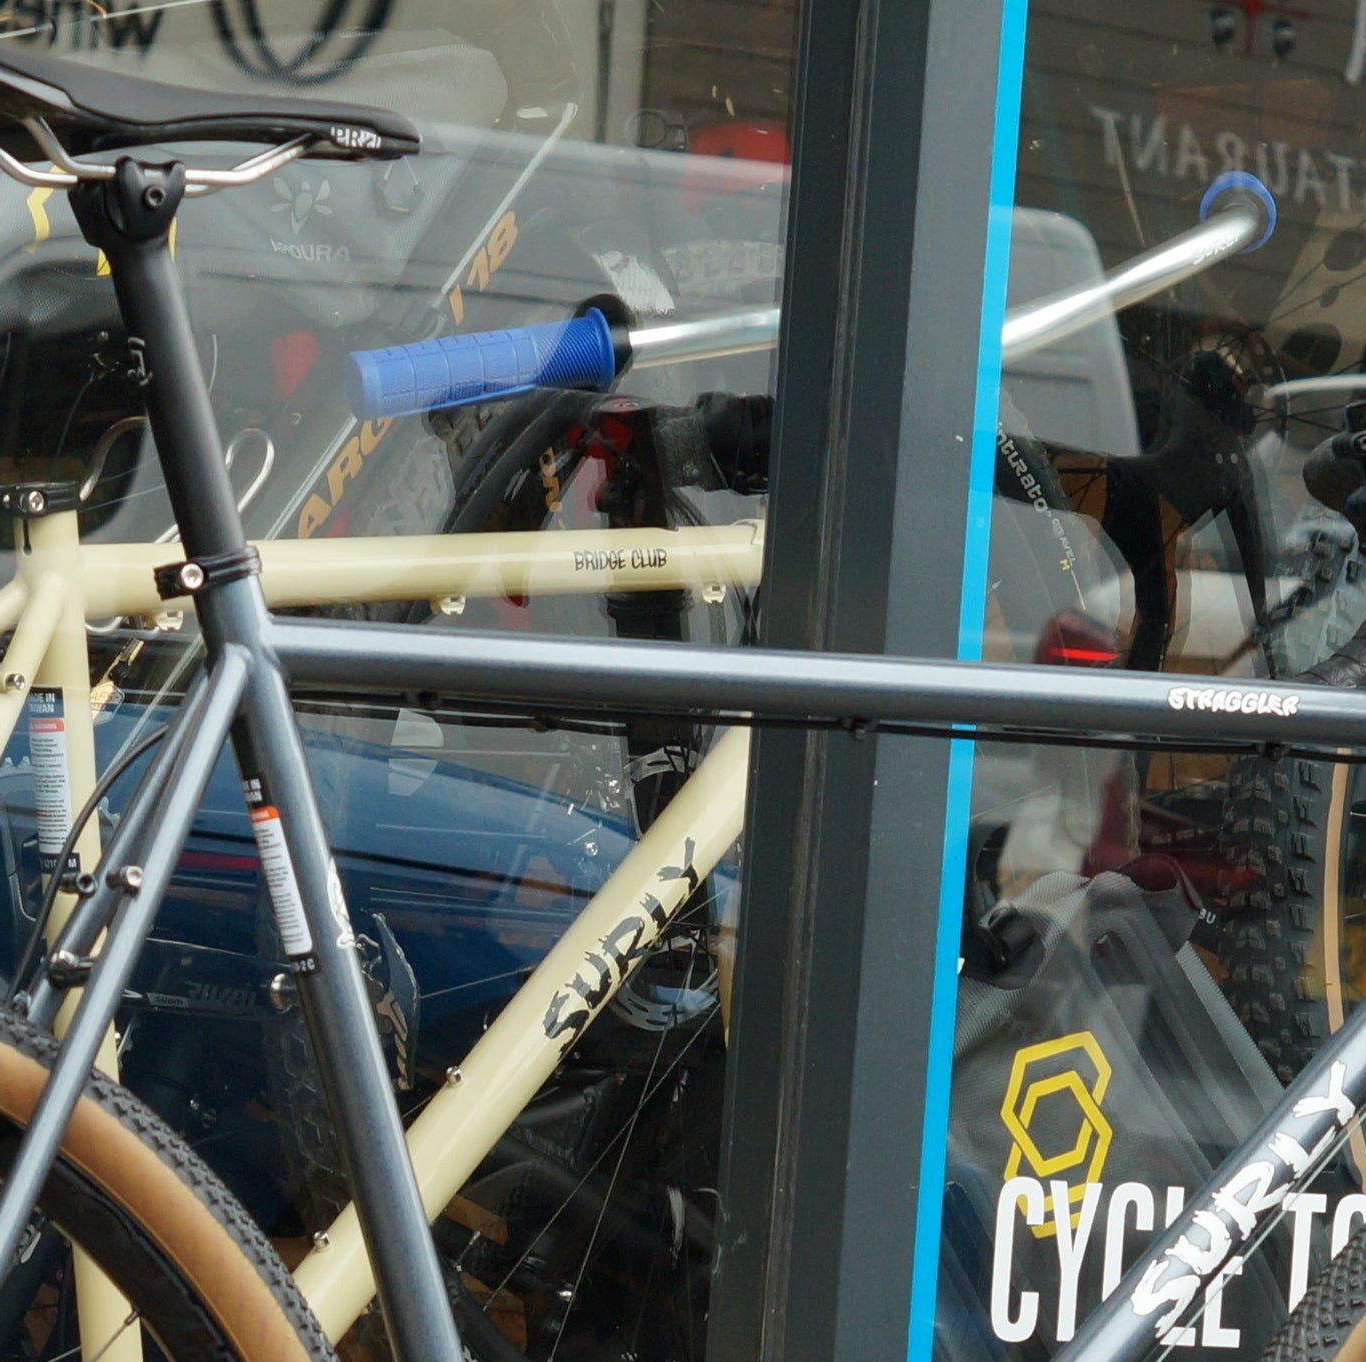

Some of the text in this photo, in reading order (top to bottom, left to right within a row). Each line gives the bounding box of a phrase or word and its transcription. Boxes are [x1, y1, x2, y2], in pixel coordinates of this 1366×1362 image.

[995, 422, 1049, 514] nturato
[573, 548, 668, 571] BRIDGE CLUB
[1168, 687, 1300, 716] STRAGGLER
[542, 836, 699, 1062] SURLY
[1132, 1060, 1357, 1339] SURLY
